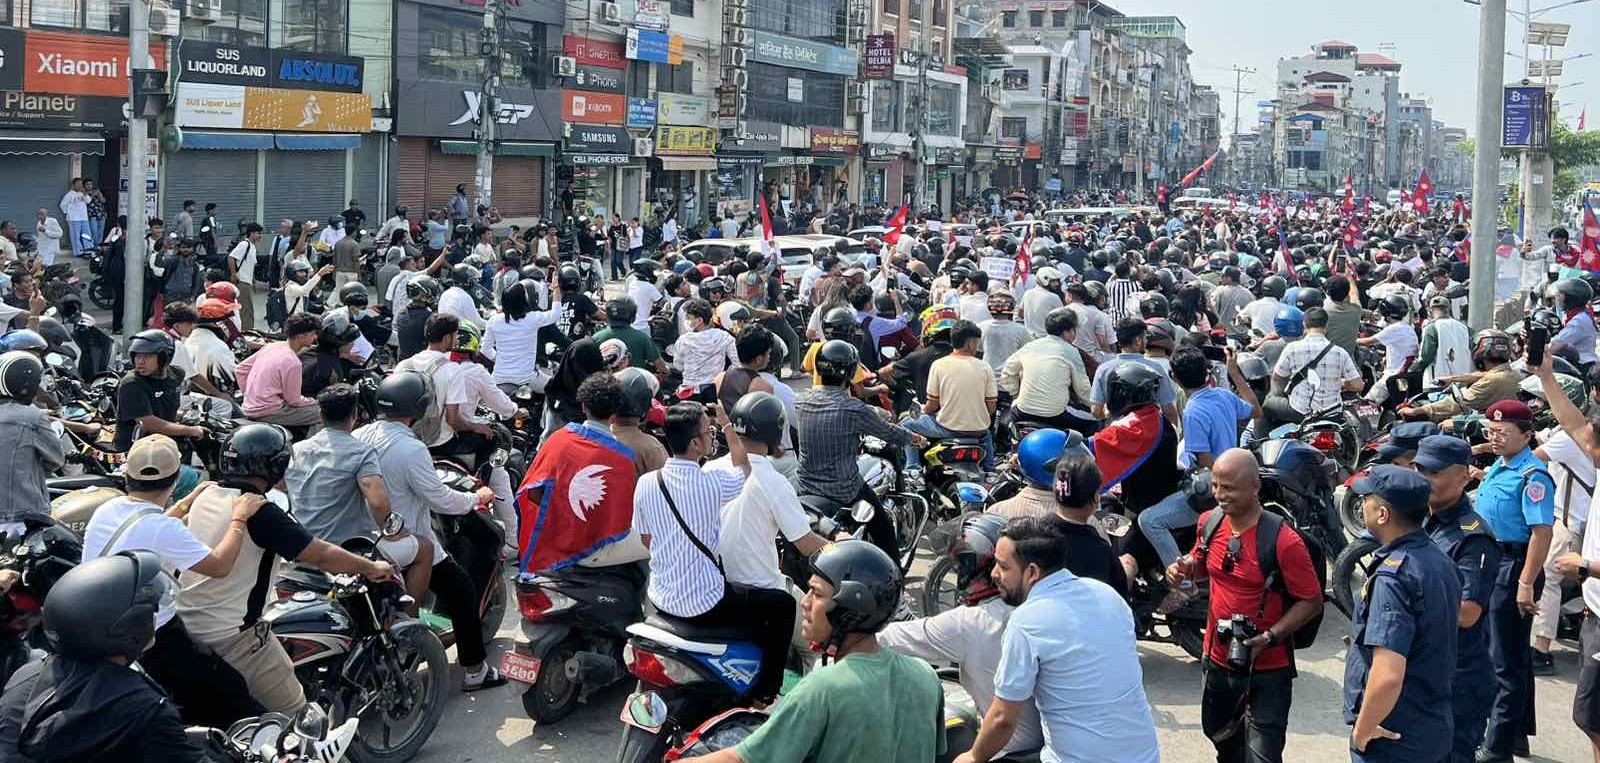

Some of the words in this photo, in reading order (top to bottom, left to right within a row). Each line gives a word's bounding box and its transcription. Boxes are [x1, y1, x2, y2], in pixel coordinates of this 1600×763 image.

[216, 48, 240, 61] SUS
[868, 48, 891, 56] HOTEL
[37, 53, 119, 78] Xiaomi
[187, 60, 267, 77] LIQUORLAND
[590, 74, 617, 88] iPhone
[5, 91, 77, 112] Planet
[448, 91, 534, 125] XEP
[581, 132, 617, 143] SAMSUNG
[573, 155, 587, 164] CELL
[588, 155, 610, 164] PHONE
[611, 156, 629, 164] STORE
